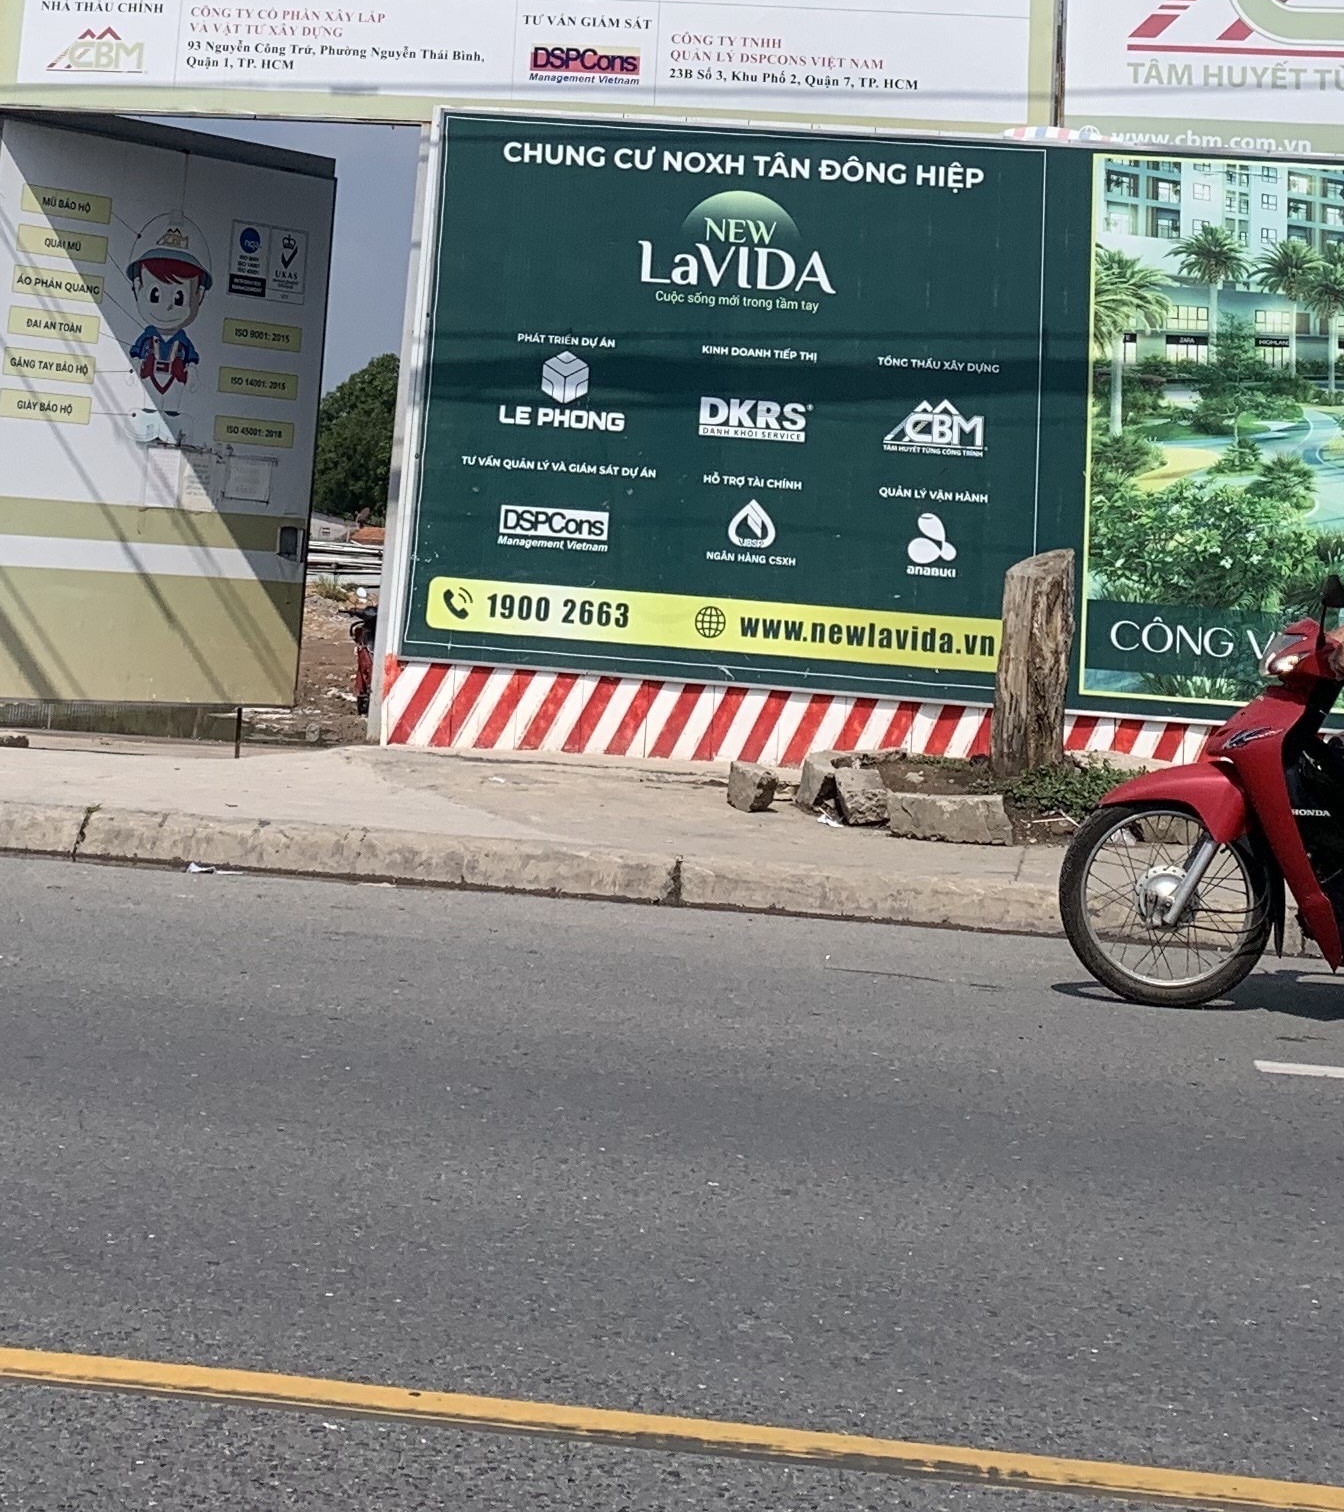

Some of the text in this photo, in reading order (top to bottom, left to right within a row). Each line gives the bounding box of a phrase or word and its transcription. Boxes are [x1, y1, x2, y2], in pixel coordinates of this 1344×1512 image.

[532, 45, 639, 73] DSPCons
[528, 71, 640, 88] Management Vietnam
[1126, 60, 1197, 88] TÂM
[1202, 60, 1308, 91] HUYẾT
[1111, 129, 1313, 154] www.cbm.com.vn
[502, 140, 984, 194] CHUNG CƯ NOXH TÂN ĐÔNG HIỆP
[704, 216, 777, 246] NEW
[637, 239, 837, 295] LaVIDA
[63, 279, 100, 295] QUANG
[654, 289, 819, 315] Cuộc sống mới trong tầm tay
[25, 317, 82, 334] ĐAI AN TOÀN
[234, 327, 249, 338] ISO
[271, 331, 290, 344] 2015
[516, 331, 546, 344] PHÁT
[580, 336, 599, 349] DỰ
[598, 336, 616, 348] ÁN
[701, 344, 817, 364] KINH DOANH TIẾP THỊ
[37, 359, 55, 371] TAY
[74, 362, 89, 377] HỘ
[942, 358, 965, 371] XÂY
[966, 361, 1000, 374] DỰNG
[16, 398, 39, 411] GIÀY
[58, 402, 73, 417] HỘ
[698, 396, 807, 432] DKRS
[498, 404, 625, 432] LE PHONG
[225, 424, 240, 435] ISO
[702, 425, 730, 438] DANH
[760, 430, 802, 442] SERVICE
[905, 412, 985, 447] CBM
[461, 454, 656, 479] TƯ VẤN QUẢN LÝ VÀ GIÁM SÁT DỰ ÁN
[702, 470, 802, 491] HỖ TRỢ TÀI CHÍNH
[878, 484, 988, 504] QUẢN LÝ VẬN HÀNH
[503, 508, 605, 537] DSPCons
[496, 534, 608, 552] Management Vietnam
[705, 549, 796, 566] NGÂN HÀNG CSXH
[486, 592, 997, 659] 1900 2663 www.newlavida.vn
[1290, 807, 1333, 818] HONDA
